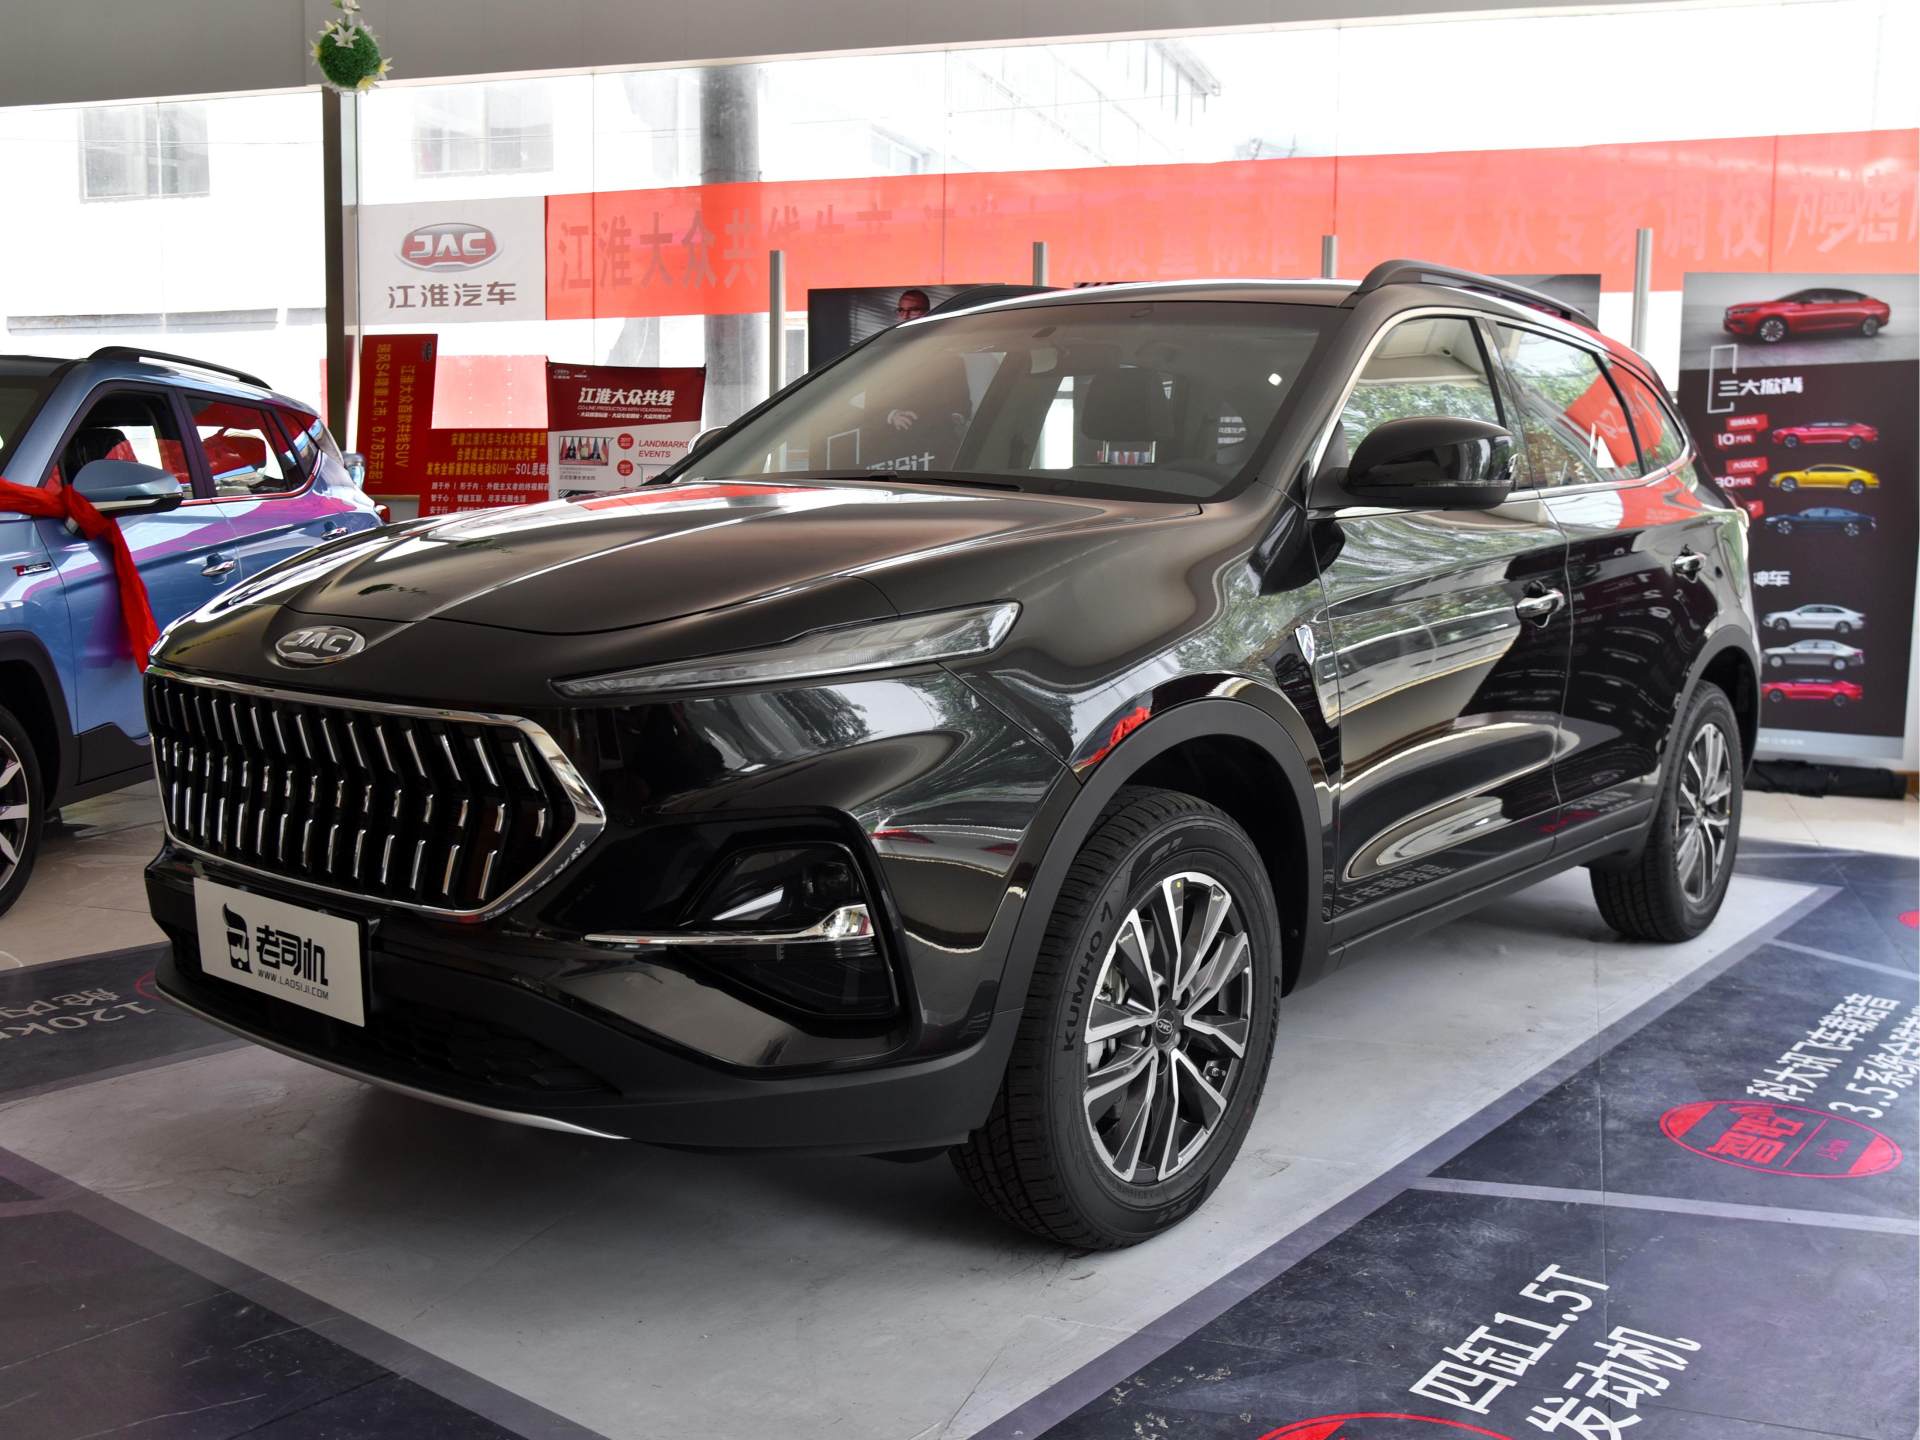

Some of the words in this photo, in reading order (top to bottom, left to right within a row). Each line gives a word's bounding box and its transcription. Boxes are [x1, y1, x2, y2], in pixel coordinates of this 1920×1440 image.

[409, 232, 487, 259] JAC
[388, 281, 517, 309] 江淮汽车
[578, 386, 676, 406] 江淮大众共线
[638, 440, 688, 449] LANDMARKS
[638, 450, 671, 458] EVENTS
[283, 631, 353, 652] JAC
[256, 924, 328, 986] 老司机
[257, 968, 329, 1000] WWW.LAOSIJI.COM
[1064, 930, 1102, 1050] KUMHO
[1746, 992, 1901, 1102] 科大讯飞车载语音
[1408, 1263, 1610, 1415] 四缸1.5T
[1526, 1326, 1702, 1440] 发动机
